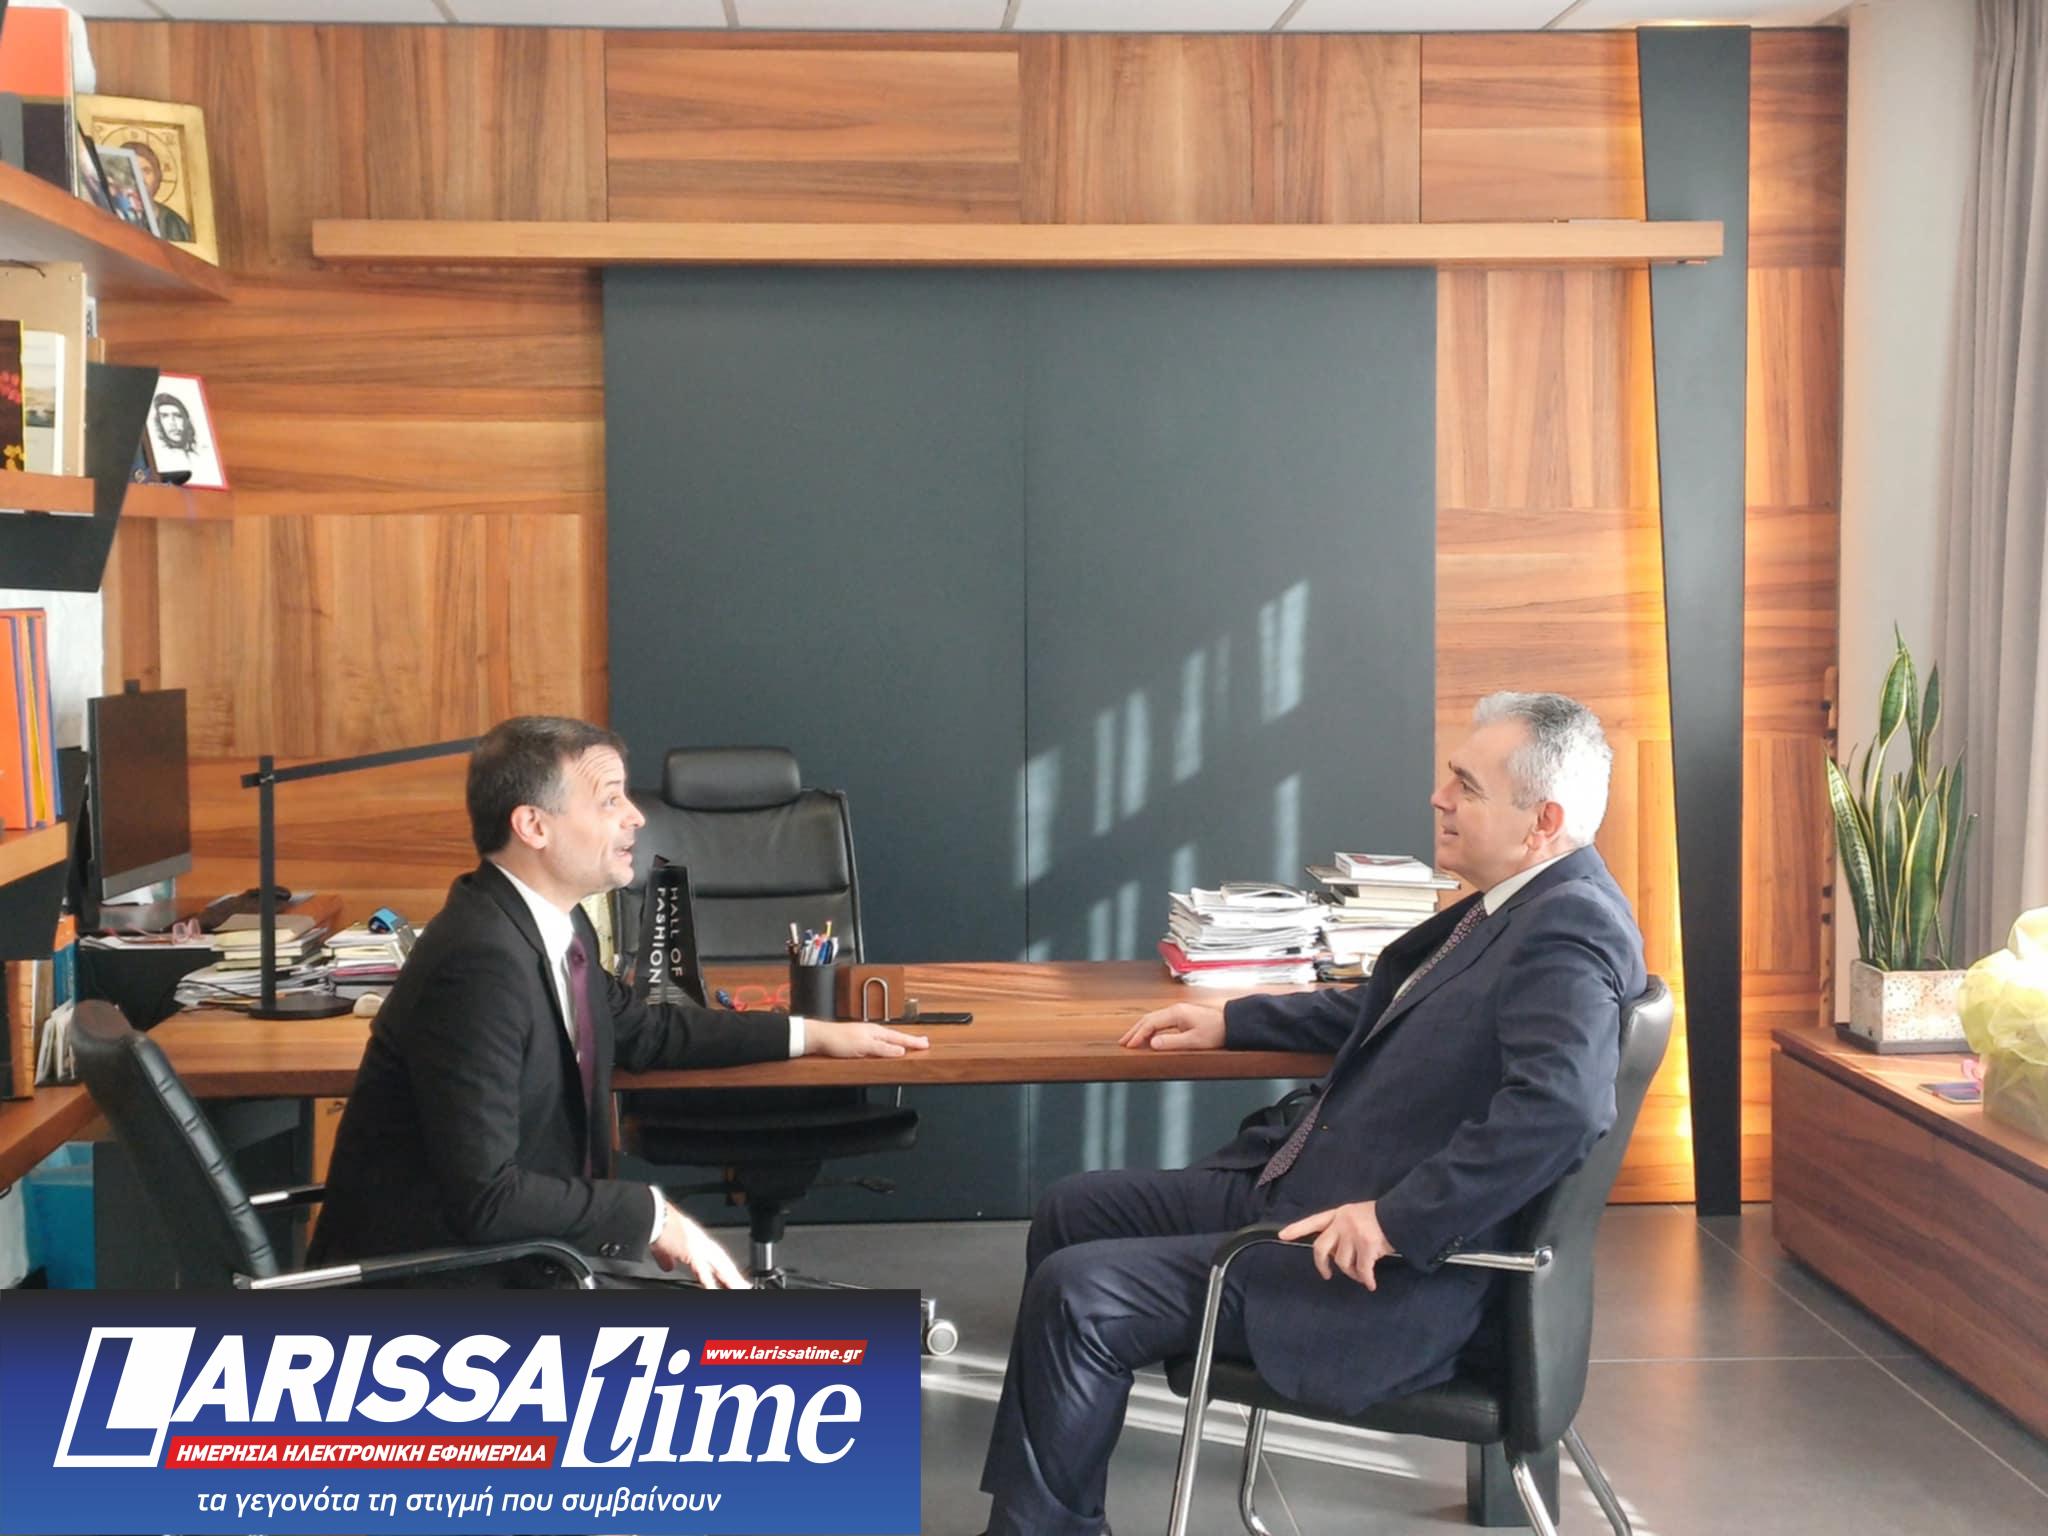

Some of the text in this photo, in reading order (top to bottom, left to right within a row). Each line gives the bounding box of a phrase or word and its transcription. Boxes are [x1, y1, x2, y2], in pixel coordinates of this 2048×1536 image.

[649, 887, 666, 983] FASHION
[670, 887, 683, 976] HALL OF
